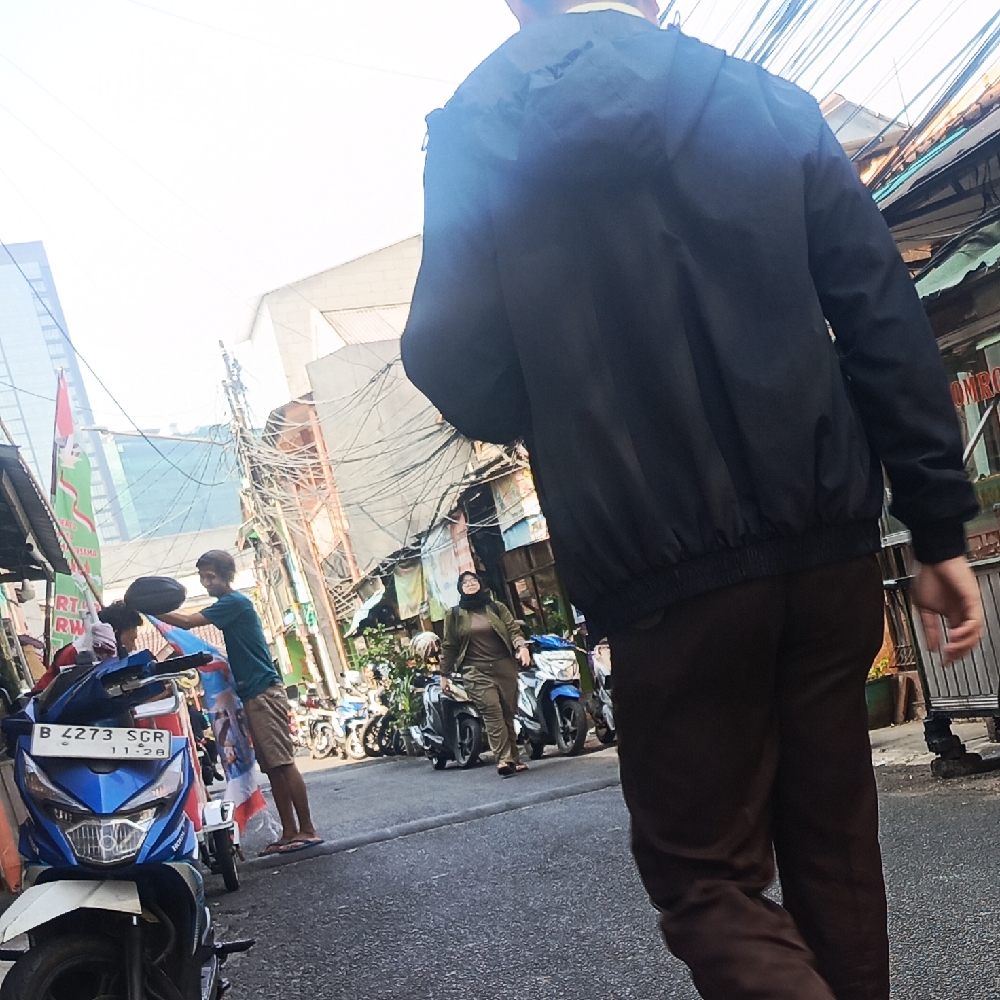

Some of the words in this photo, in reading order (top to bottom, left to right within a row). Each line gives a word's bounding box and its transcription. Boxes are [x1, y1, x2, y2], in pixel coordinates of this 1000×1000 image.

[55, 594, 79, 613] RT
[55, 616, 86, 636] RW
[39, 727, 51, 739] B
[61, 728, 113, 741] 4273
